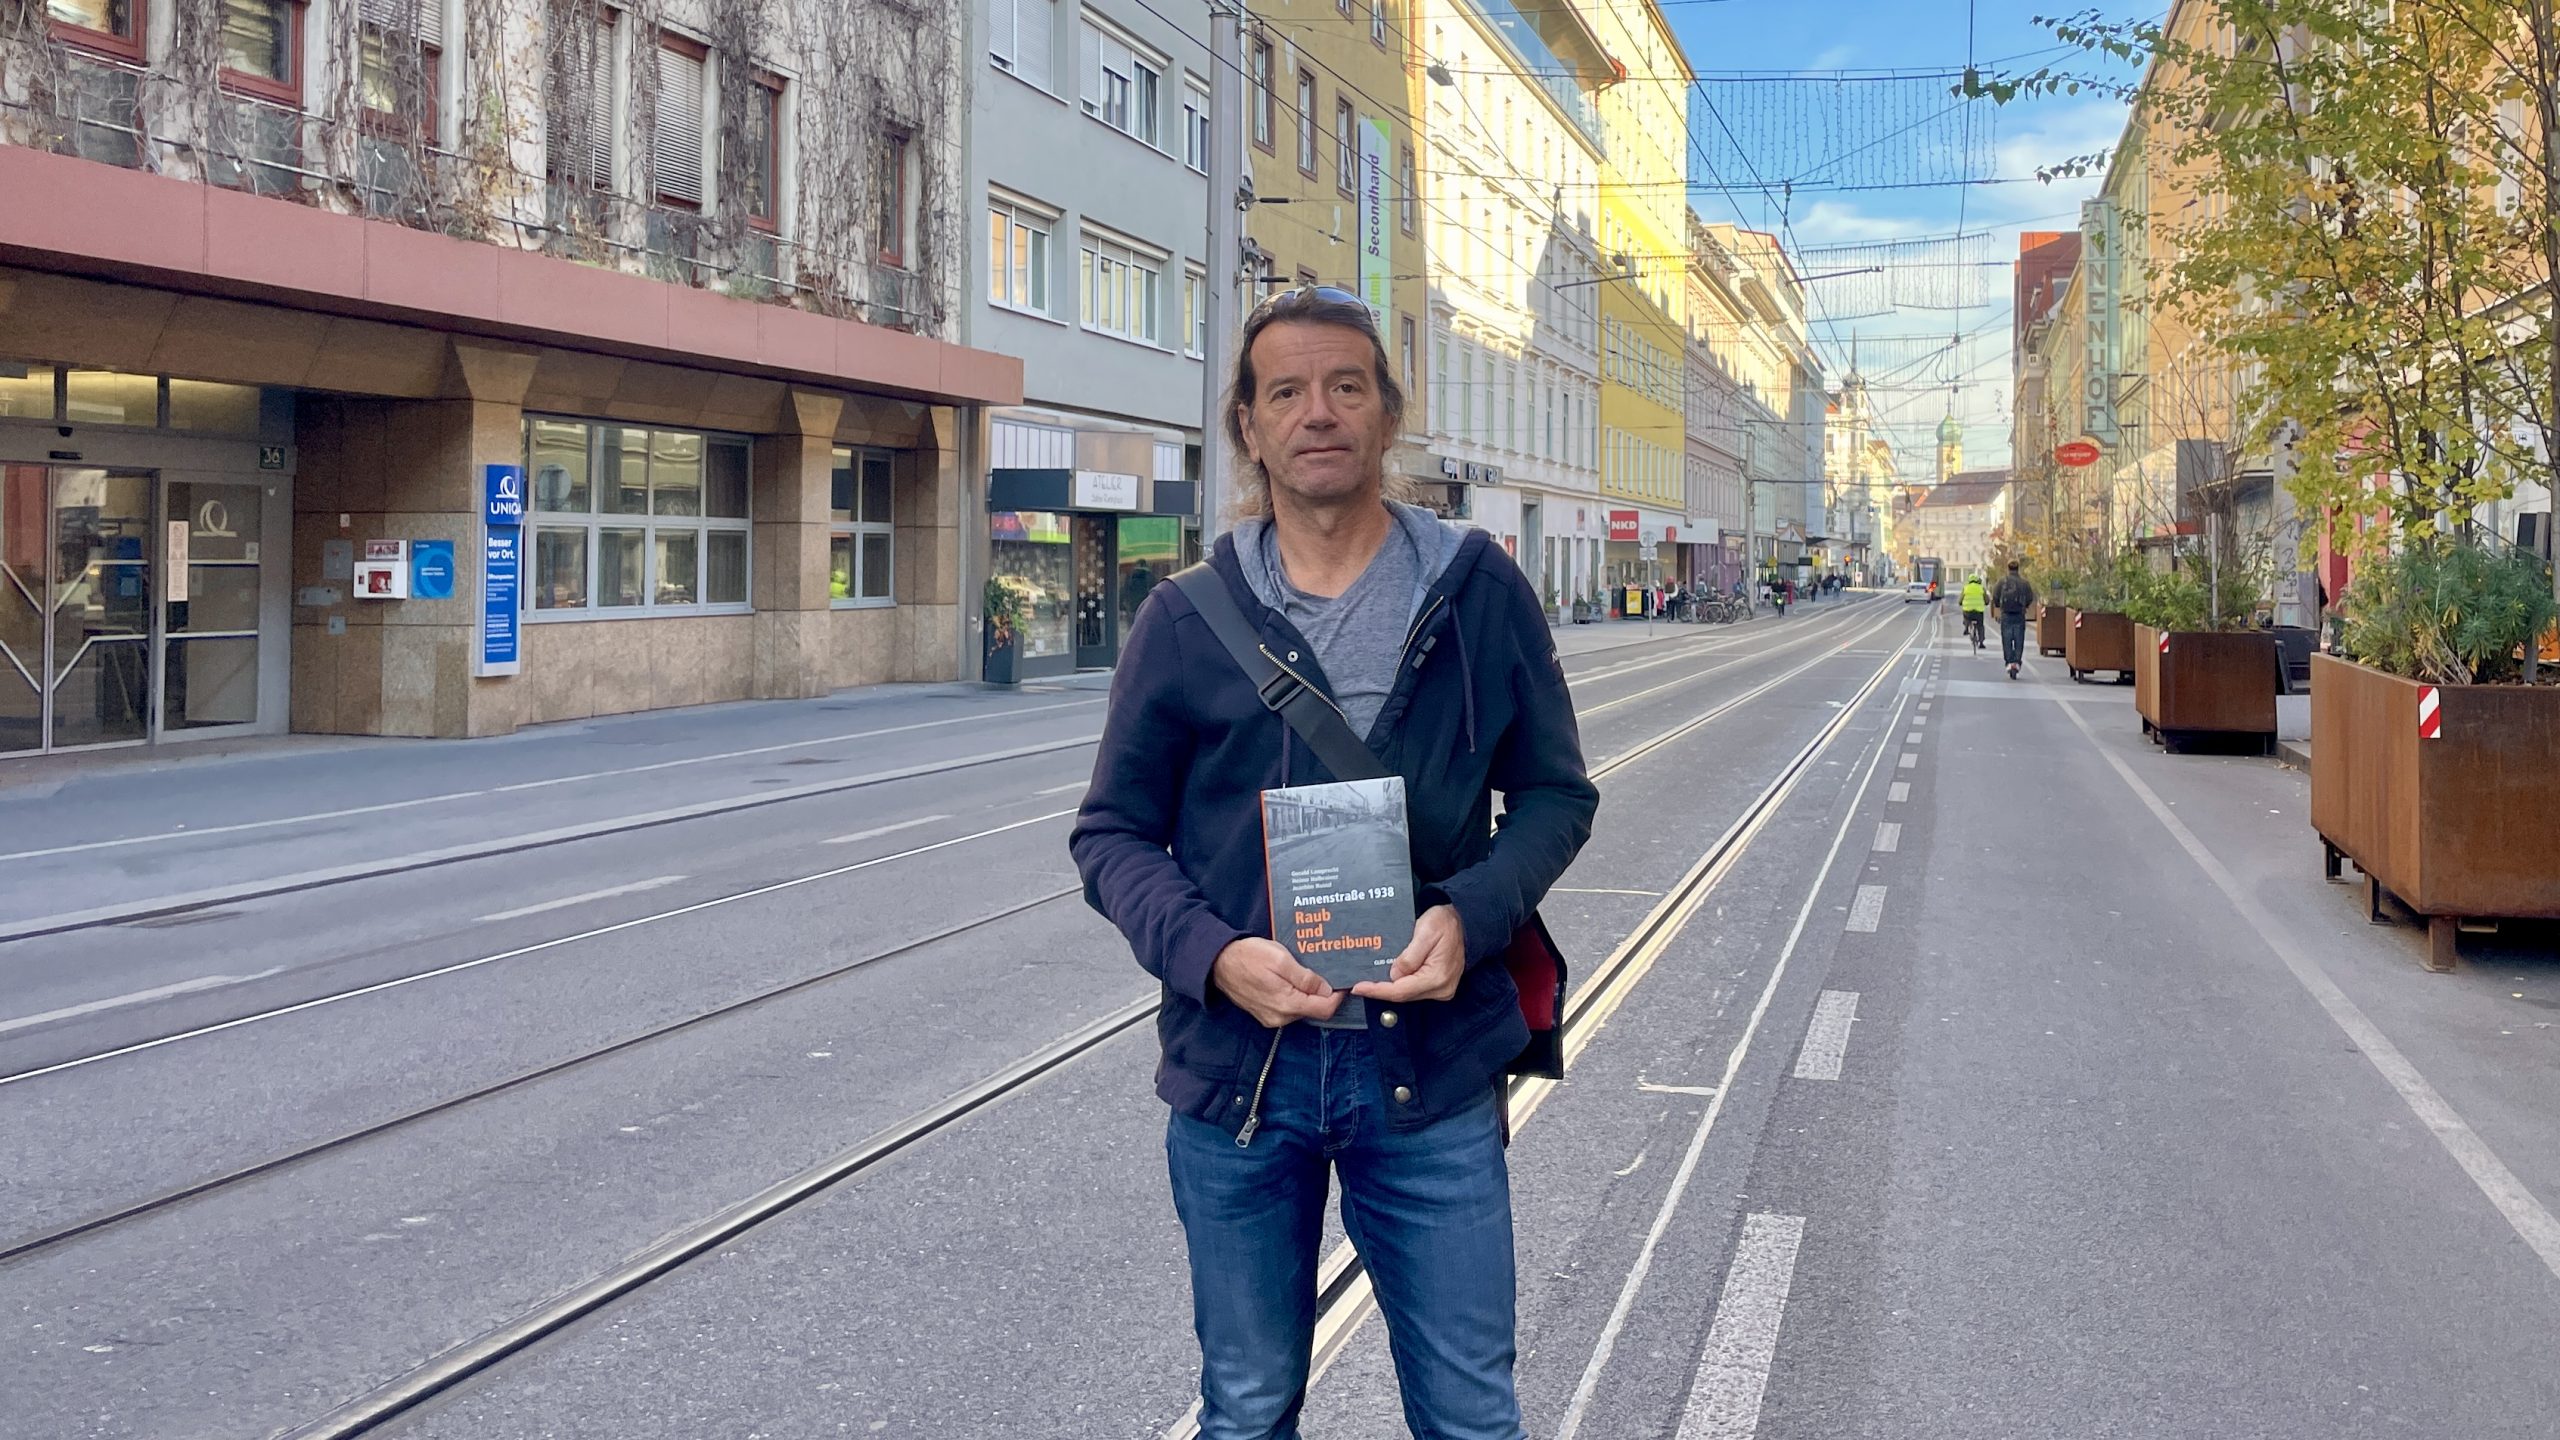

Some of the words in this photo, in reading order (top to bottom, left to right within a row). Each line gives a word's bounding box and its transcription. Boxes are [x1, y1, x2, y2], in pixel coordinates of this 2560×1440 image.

[1368, 153, 1380, 257] Secondhand
[264, 447, 281, 464] 36
[1611, 520, 1638, 531] NKD
[488, 537, 512, 547] Besser
[488, 551, 500, 559] vor
[501, 549, 516, 560] Ort.
[1293, 889, 1365, 906] Annenstraße
[1368, 886, 1395, 899] 1938
[1295, 908, 1331, 924] Raub
[1296, 923, 1323, 938] und
[1297, 935, 1382, 953] Vertreibung
